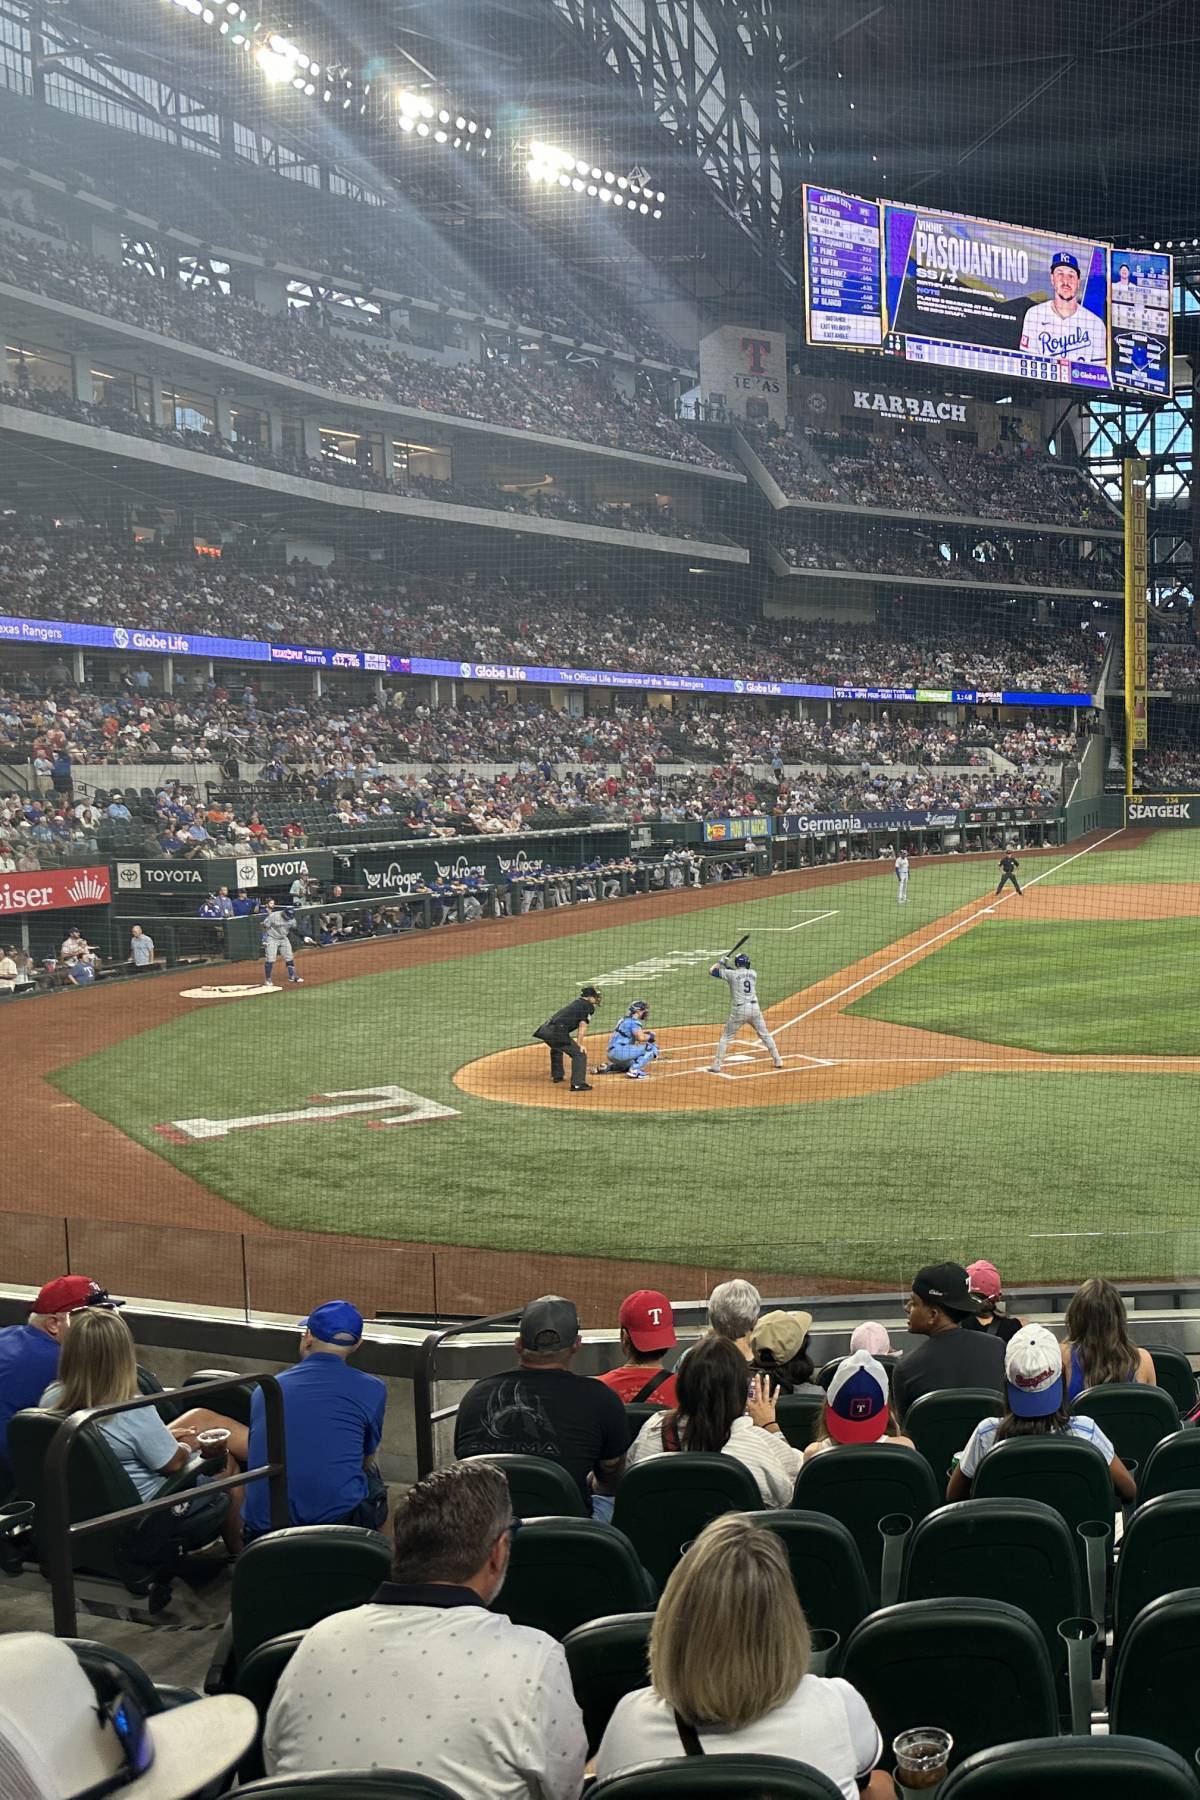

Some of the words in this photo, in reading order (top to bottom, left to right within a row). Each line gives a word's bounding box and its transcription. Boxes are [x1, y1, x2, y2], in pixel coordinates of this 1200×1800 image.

[917, 219, 944, 234] VINNIE
[916, 232, 1029, 284] PASQUANTINO
[916, 286, 941, 296] NOTE
[1038, 326, 1089, 359] Royals
[741, 337, 771, 375] T
[1080, 371, 1096, 381] Globe
[1096, 373, 1108, 382] Life
[853, 390, 967, 422] KARBACH
[914, 416, 941, 425] COMPANY
[22, 624, 63, 641] Rangers
[132, 633, 167, 649] Globe
[168, 636, 189, 652] Life
[1134, 622, 1145, 685] HEAT
[474, 664, 505, 679] Globe
[506, 666, 526, 680] Life
[560, 671, 572, 681] The
[573, 671, 598, 683] Official
[599, 673, 611, 683] Life
[612, 675, 643, 686] Insurance
[643, 676, 651, 686] of
[651, 677, 662, 687] the
[662, 678, 680, 688] Texas
[680, 679, 704, 691] Rangers
[746, 682, 768, 694] Globe
[768, 684, 781, 694] Life
[1129, 803, 1191, 820] SEATGEEK
[798, 815, 862, 833] Germania
[145, 869, 202, 883] TOYOTA
[260, 861, 308, 878] TOYOTA
[382, 862, 422, 896] Kroger
[744, 980, 751, 994] 9
[648, 1308, 663, 1325] T
[1014, 1368, 1055, 1388] Rangers
[856, 1404, 866, 1413] T
